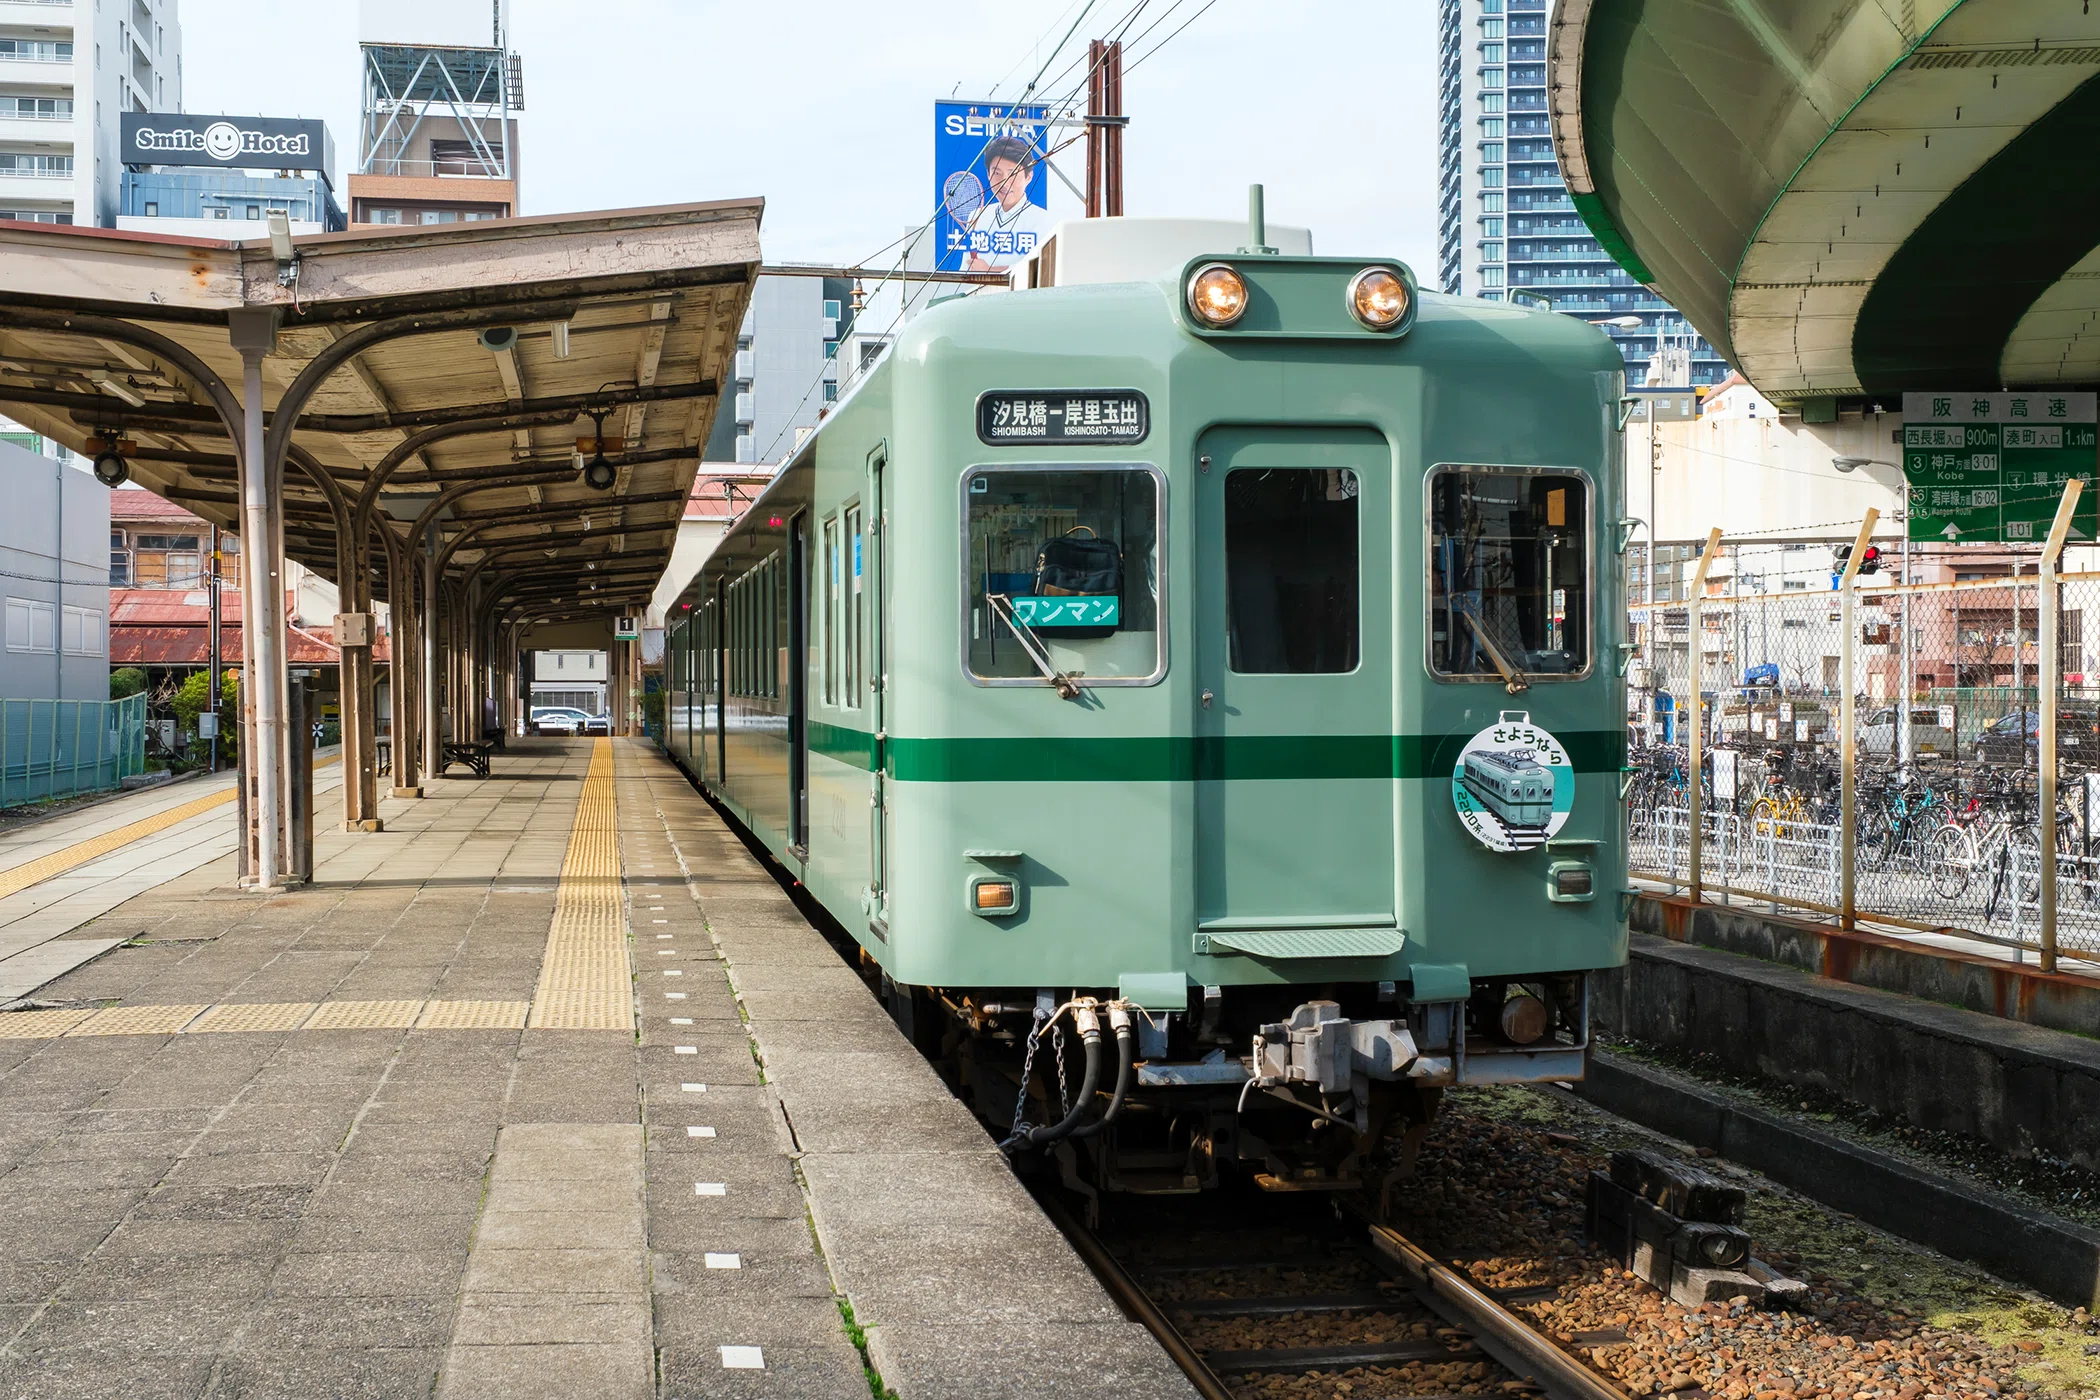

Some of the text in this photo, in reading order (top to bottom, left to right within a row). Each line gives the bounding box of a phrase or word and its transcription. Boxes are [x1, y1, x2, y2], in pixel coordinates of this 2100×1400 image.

[136, 128, 309, 155] Smile Hotel
[947, 229, 1037, 253] 土地活用
[1933, 398, 2067, 418] 阪神高速
[992, 426, 1139, 436] SHIOMIBASHI KISHINOSATO-TAMADE
[1907, 429, 1998, 446] 西長堀入口 900m
[2006, 429, 2095, 446] 湊町入口 1.1km
[1913, 456, 1922, 469] 3
[1931, 454, 1971, 471] 神戸方面
[1937, 471, 1965, 480] Kobe
[2013, 477, 2019, 489] 1
[1015, 600, 1115, 623] ワンマン
[623, 619, 628, 629] 1
[1493, 727, 1562, 765] さようなら
